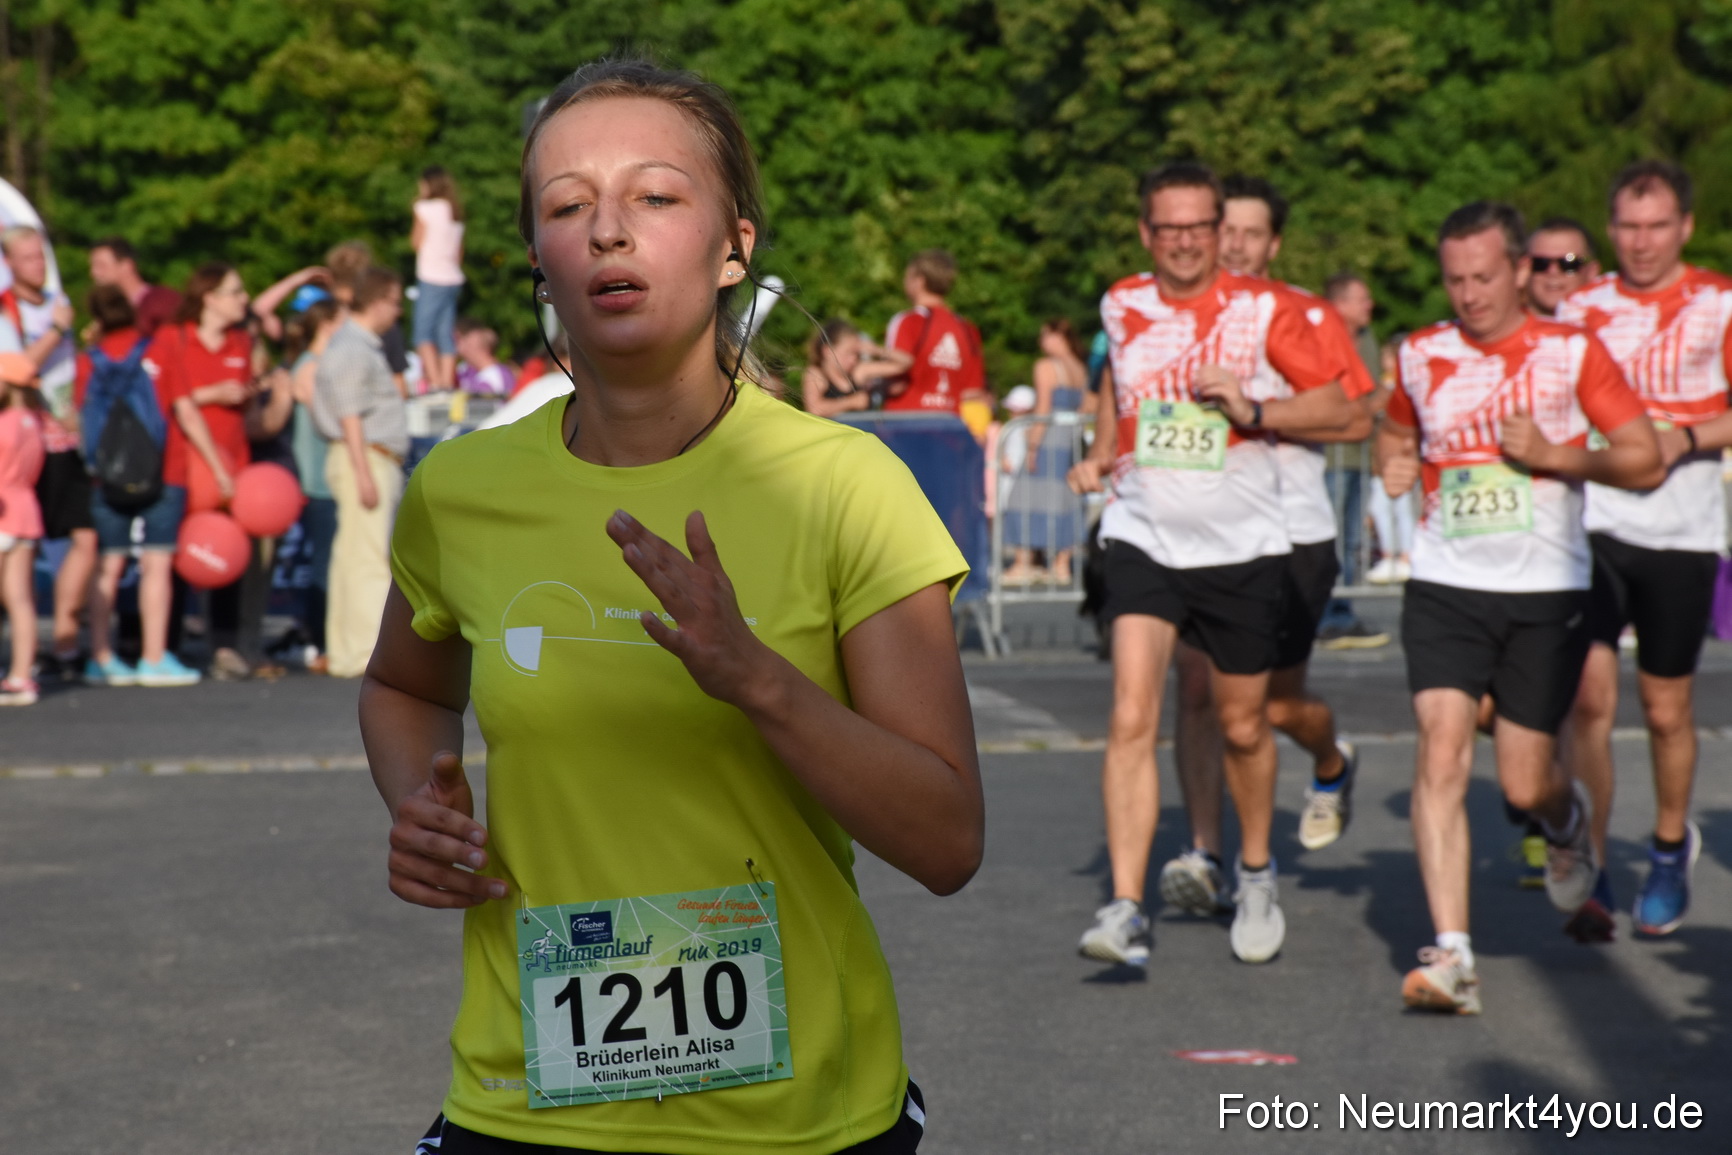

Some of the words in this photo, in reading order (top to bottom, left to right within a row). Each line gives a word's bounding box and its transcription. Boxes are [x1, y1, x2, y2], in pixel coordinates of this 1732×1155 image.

[1147, 423, 1214, 453] 2235
[1451, 487, 1519, 517] 2233
[677, 898, 722, 910] Gesunde
[556, 935, 653, 962] firmenlauf
[717, 937, 762, 957] 2019
[556, 961, 597, 971] neumarkt
[554, 960, 748, 1047] 1210
[576, 1046, 680, 1068] Brüderlein
[685, 1038, 735, 1057] Alisa
[592, 1067, 651, 1083] Klinikum
[655, 1058, 720, 1076] Neumarkt
